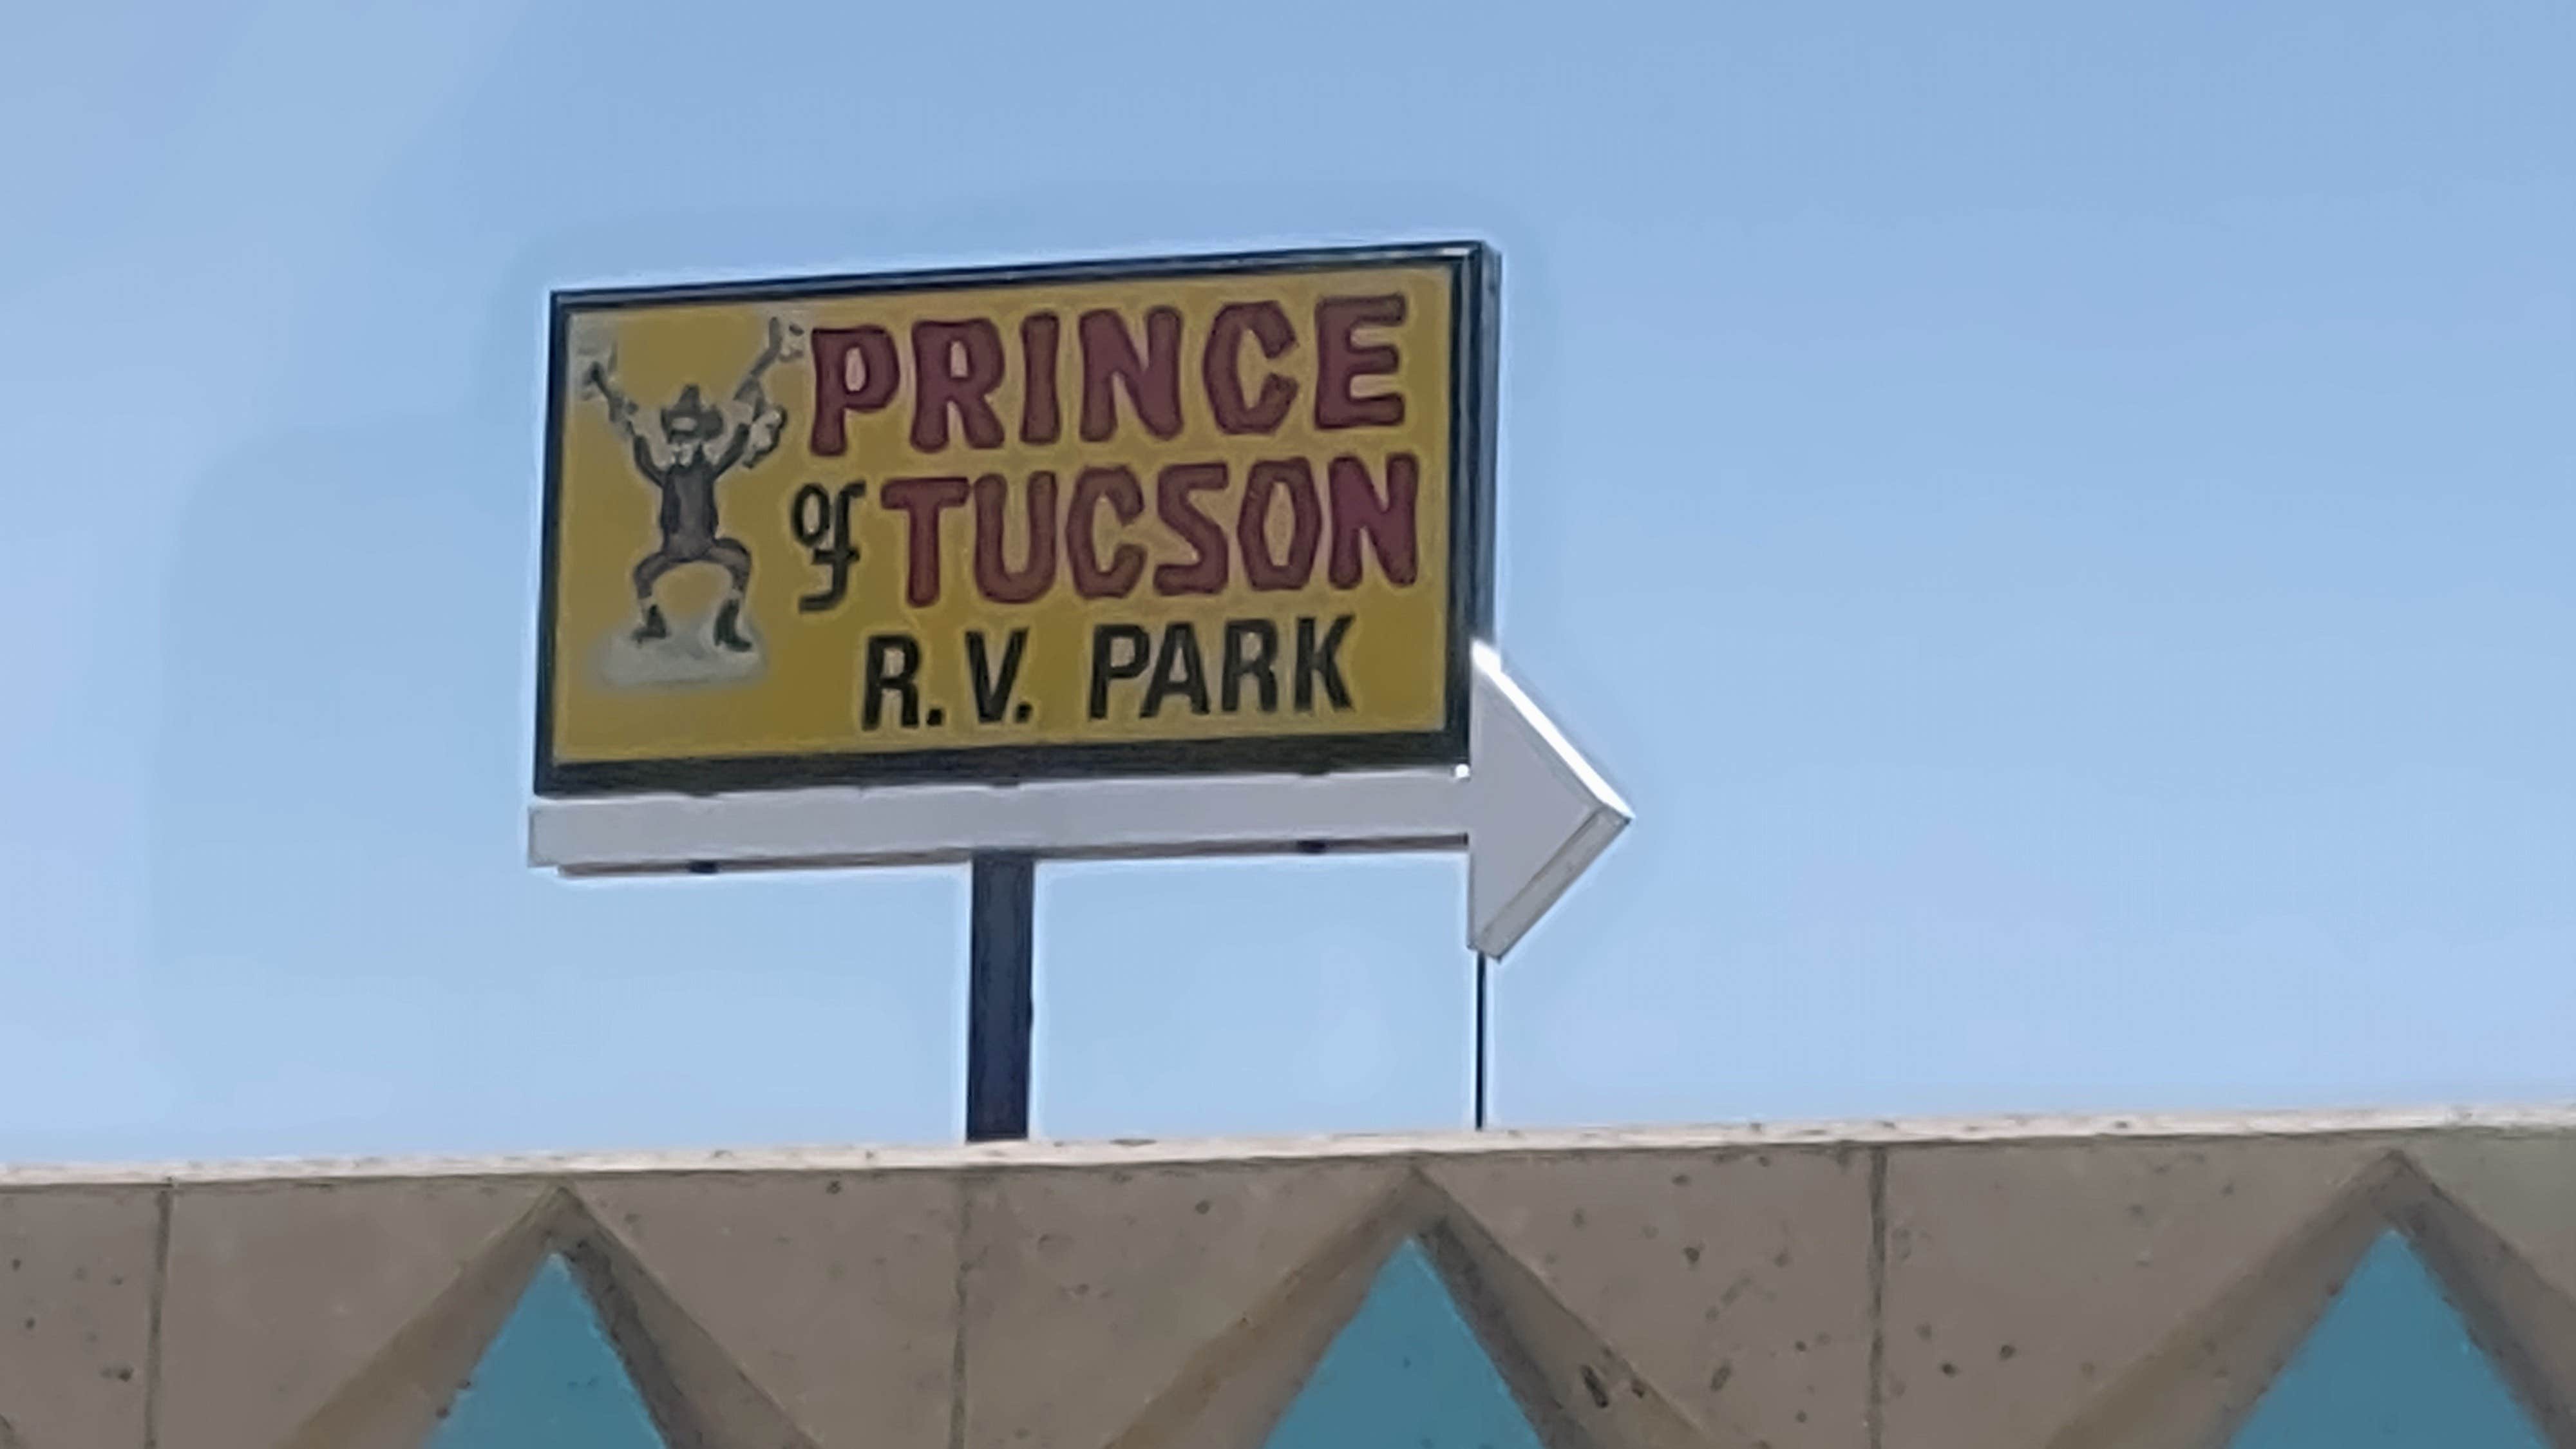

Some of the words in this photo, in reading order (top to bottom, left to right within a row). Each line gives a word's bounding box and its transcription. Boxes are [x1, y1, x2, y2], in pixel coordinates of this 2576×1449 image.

[808, 293, 1409, 459] PRINCE
[791, 479, 867, 613] of
[879, 451, 1419, 608] TUCSON
[861, 629, 1033, 732] R.V.
[1088, 614, 1356, 721] PARK
